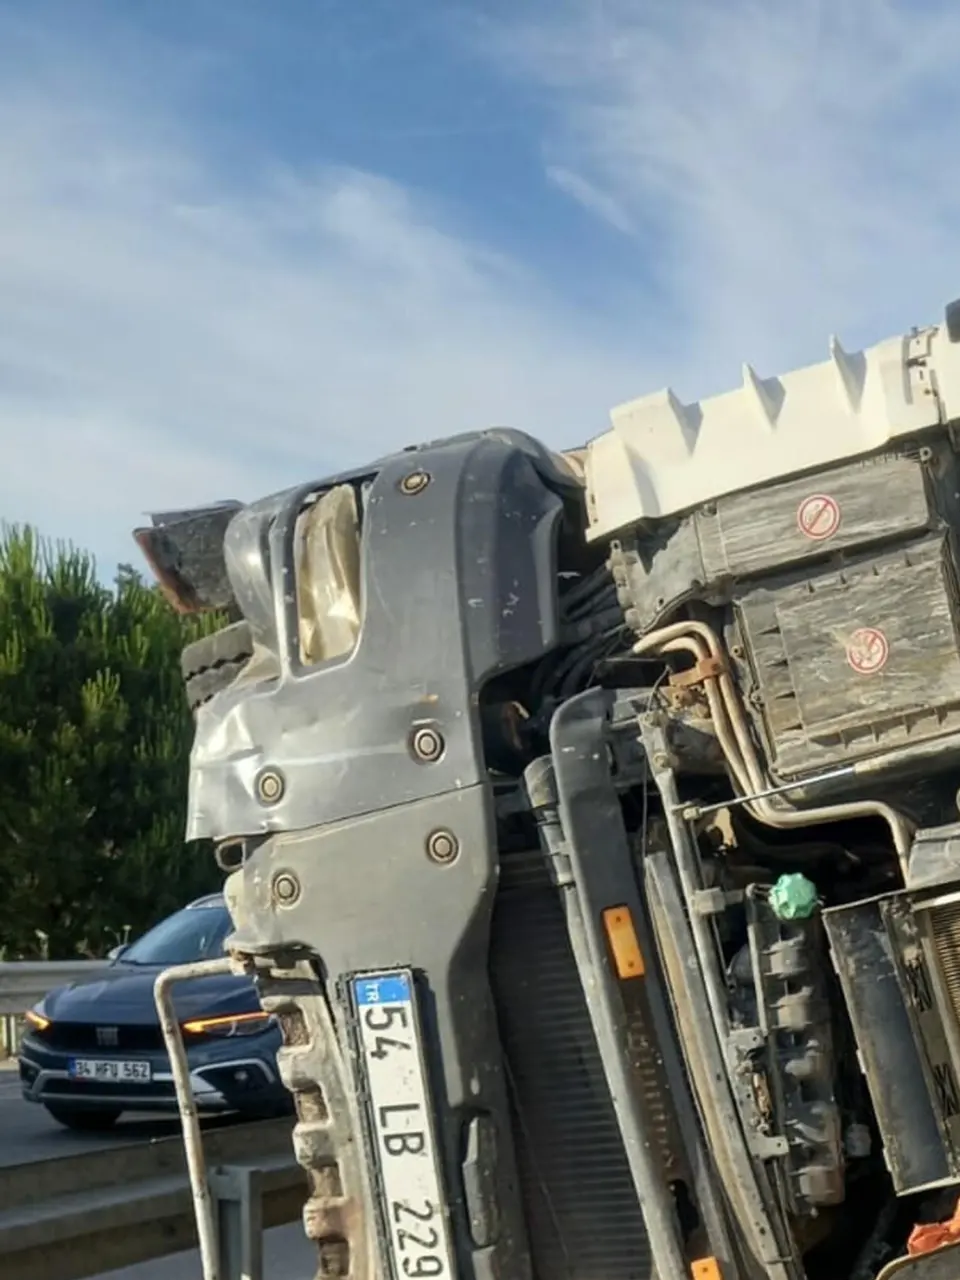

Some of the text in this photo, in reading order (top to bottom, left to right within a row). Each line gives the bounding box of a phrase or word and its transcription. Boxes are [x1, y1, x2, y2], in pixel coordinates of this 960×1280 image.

[364, 983, 380, 1002] TR
[76, 1061, 91, 1076] 34
[123, 1062, 148, 1079] 562
[365, 1007, 444, 1278] 54 LB 229
